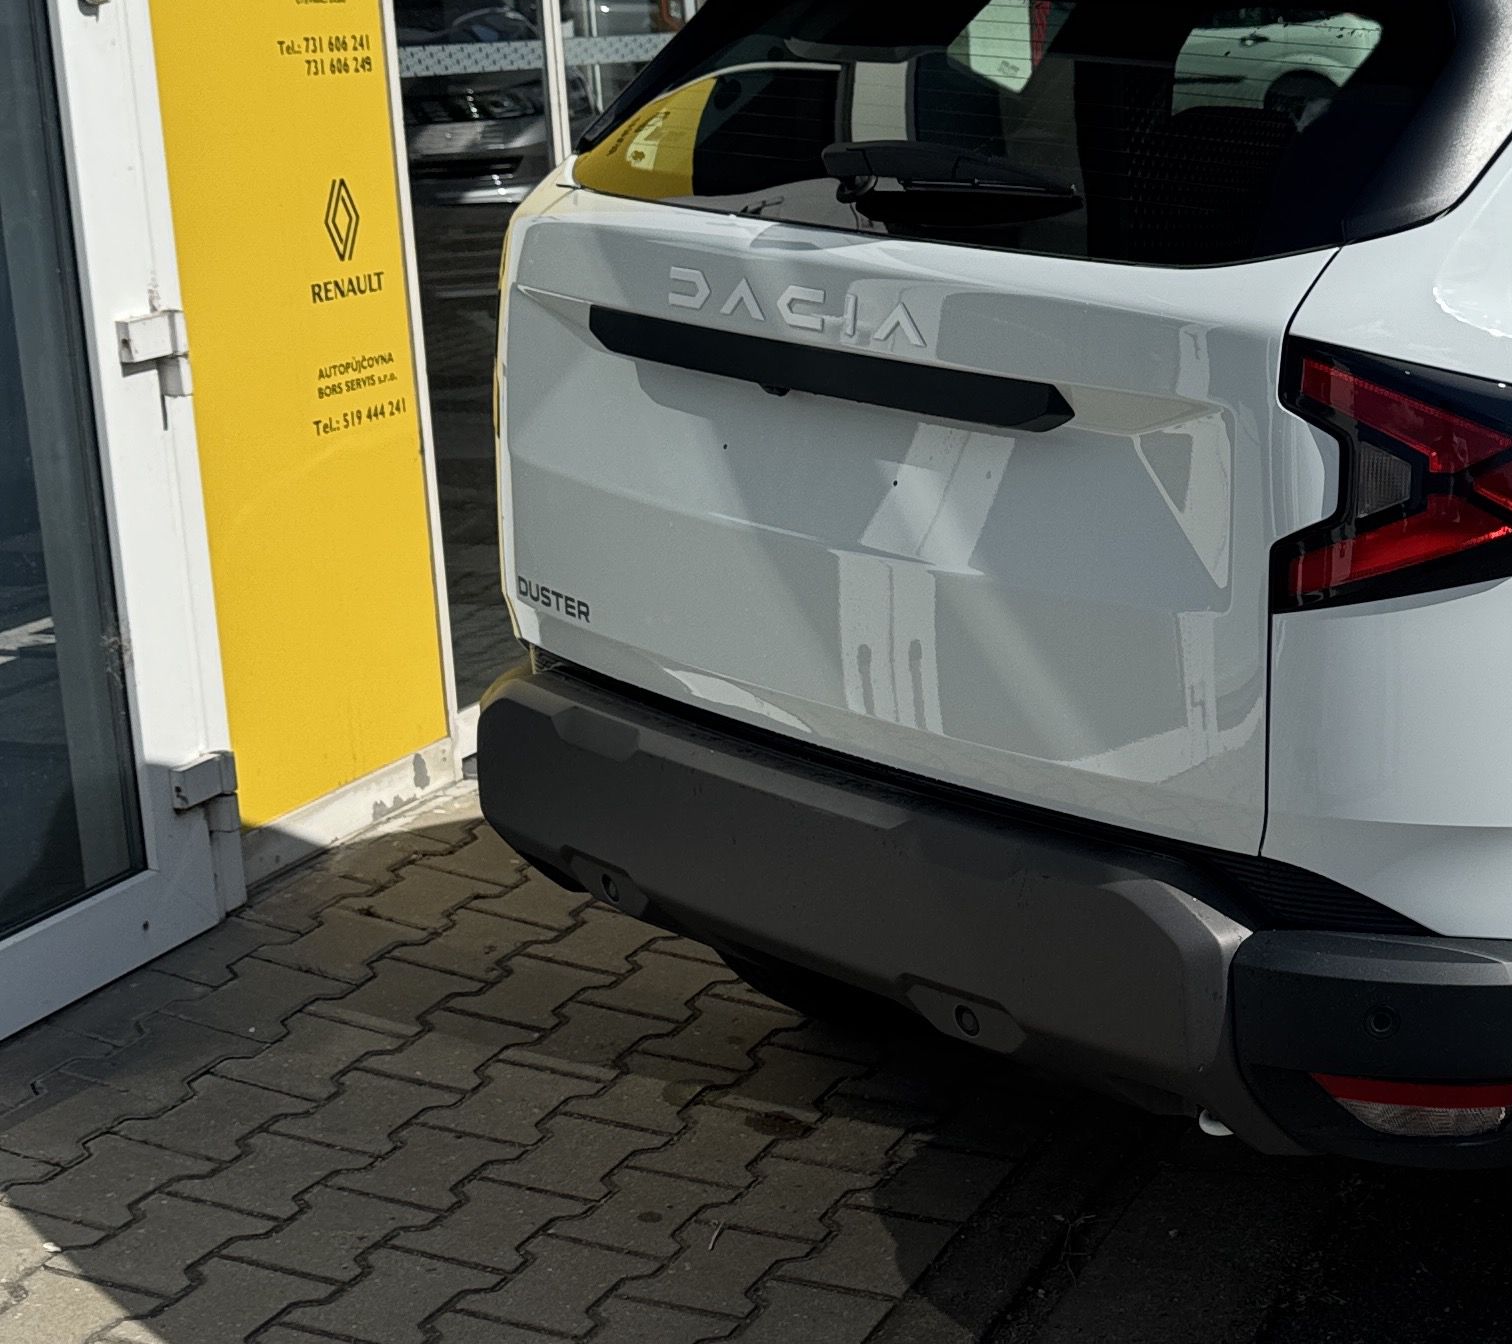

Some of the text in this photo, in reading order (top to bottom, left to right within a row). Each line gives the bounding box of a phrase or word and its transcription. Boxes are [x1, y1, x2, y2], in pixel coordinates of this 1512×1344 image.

[277, 34, 370, 55] Tel.: 731 606 241
[305, 58, 325, 76] 731
[329, 56, 349, 74] 606
[311, 271, 384, 304] RENAULT
[668, 265, 928, 348] DACIA
[318, 352, 394, 380] AUTOPŮJČOVNA
[317, 382, 343, 399] BORS
[345, 374, 376, 392] SERVIS
[313, 397, 407, 436] Tel.: 519 444 241
[517, 575, 591, 624] DUSTER
